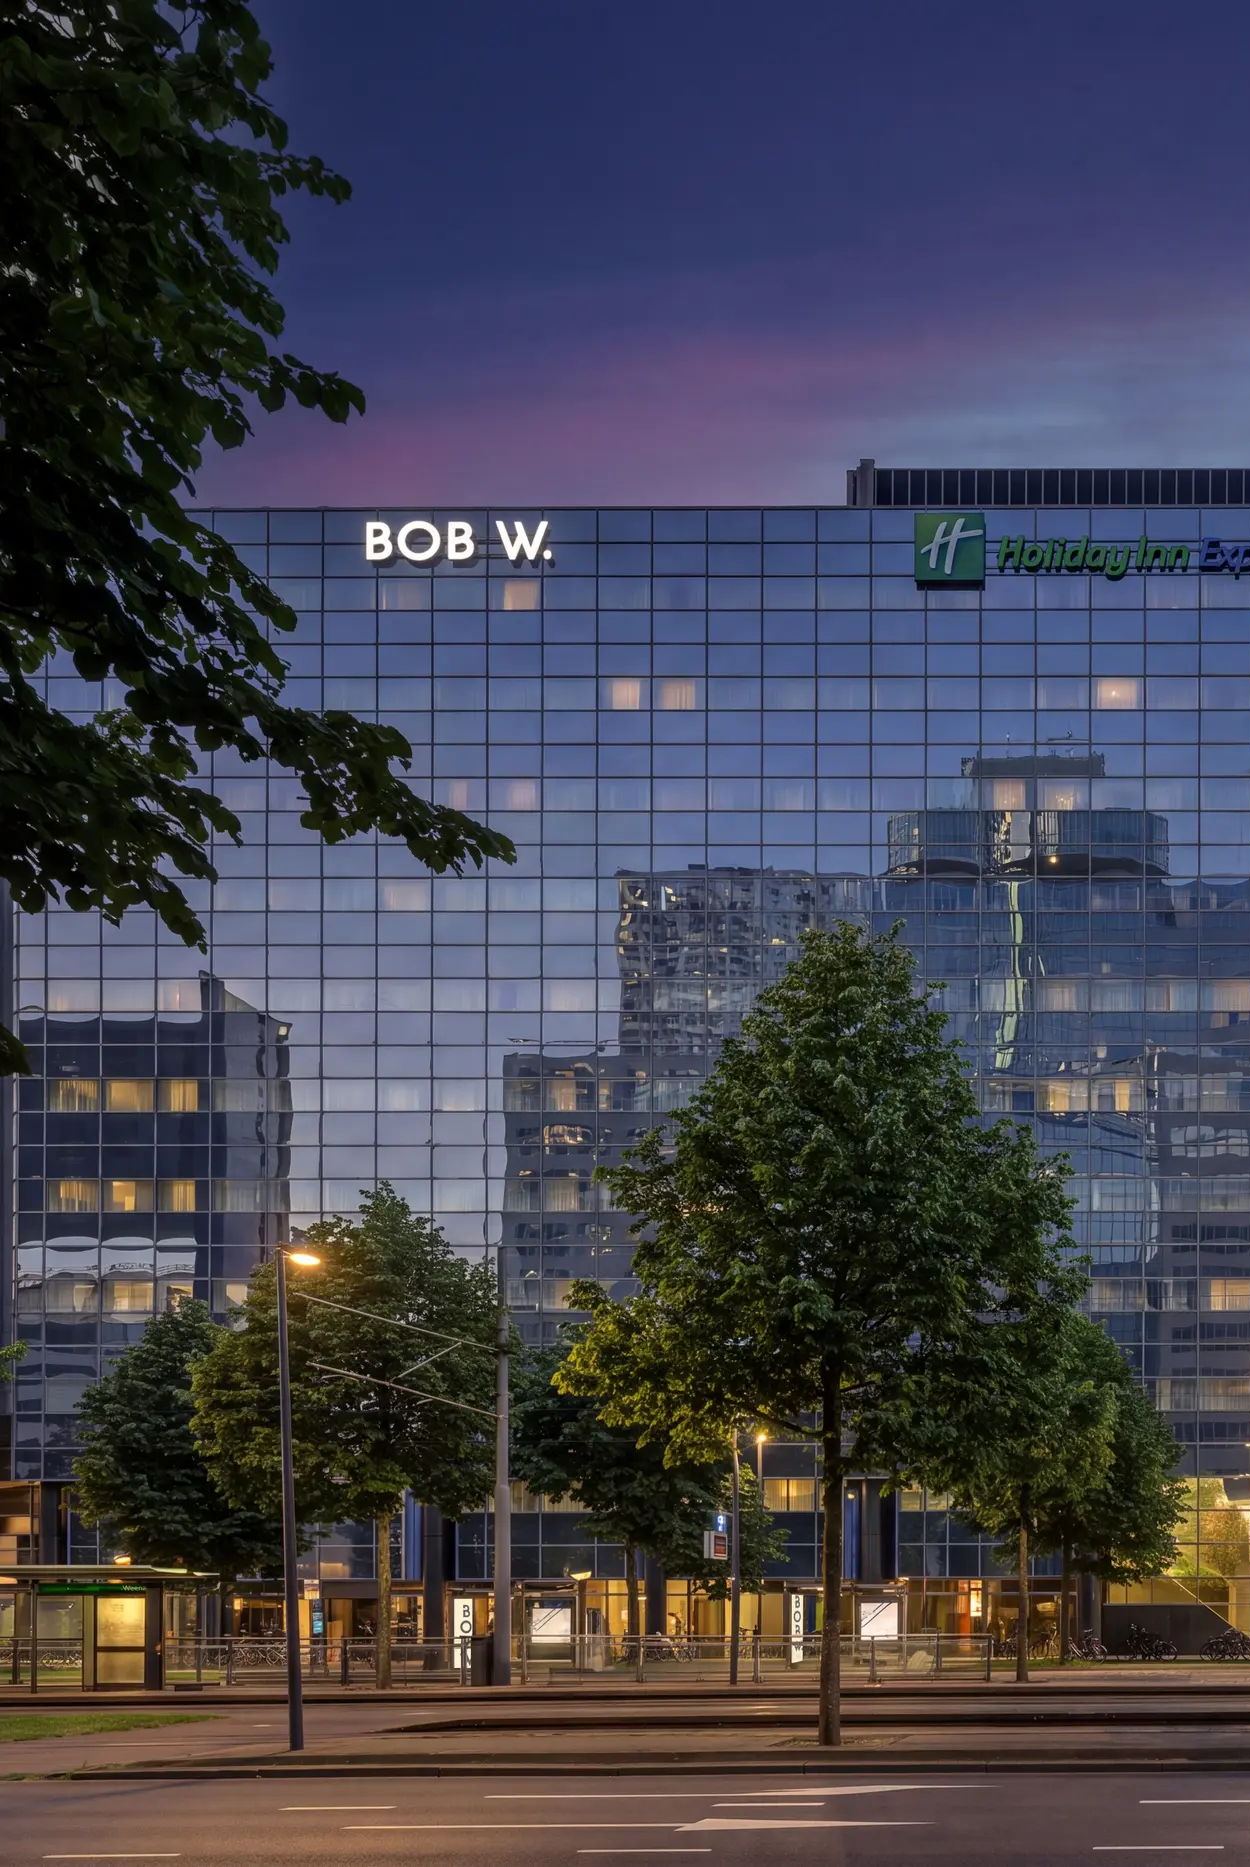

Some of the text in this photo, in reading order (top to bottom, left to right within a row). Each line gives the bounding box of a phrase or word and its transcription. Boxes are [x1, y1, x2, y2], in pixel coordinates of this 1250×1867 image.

[365, 520, 553, 562] BOB W.
[996, 535, 1131, 576] Holiday
[1135, 535, 1191, 568] Inn
